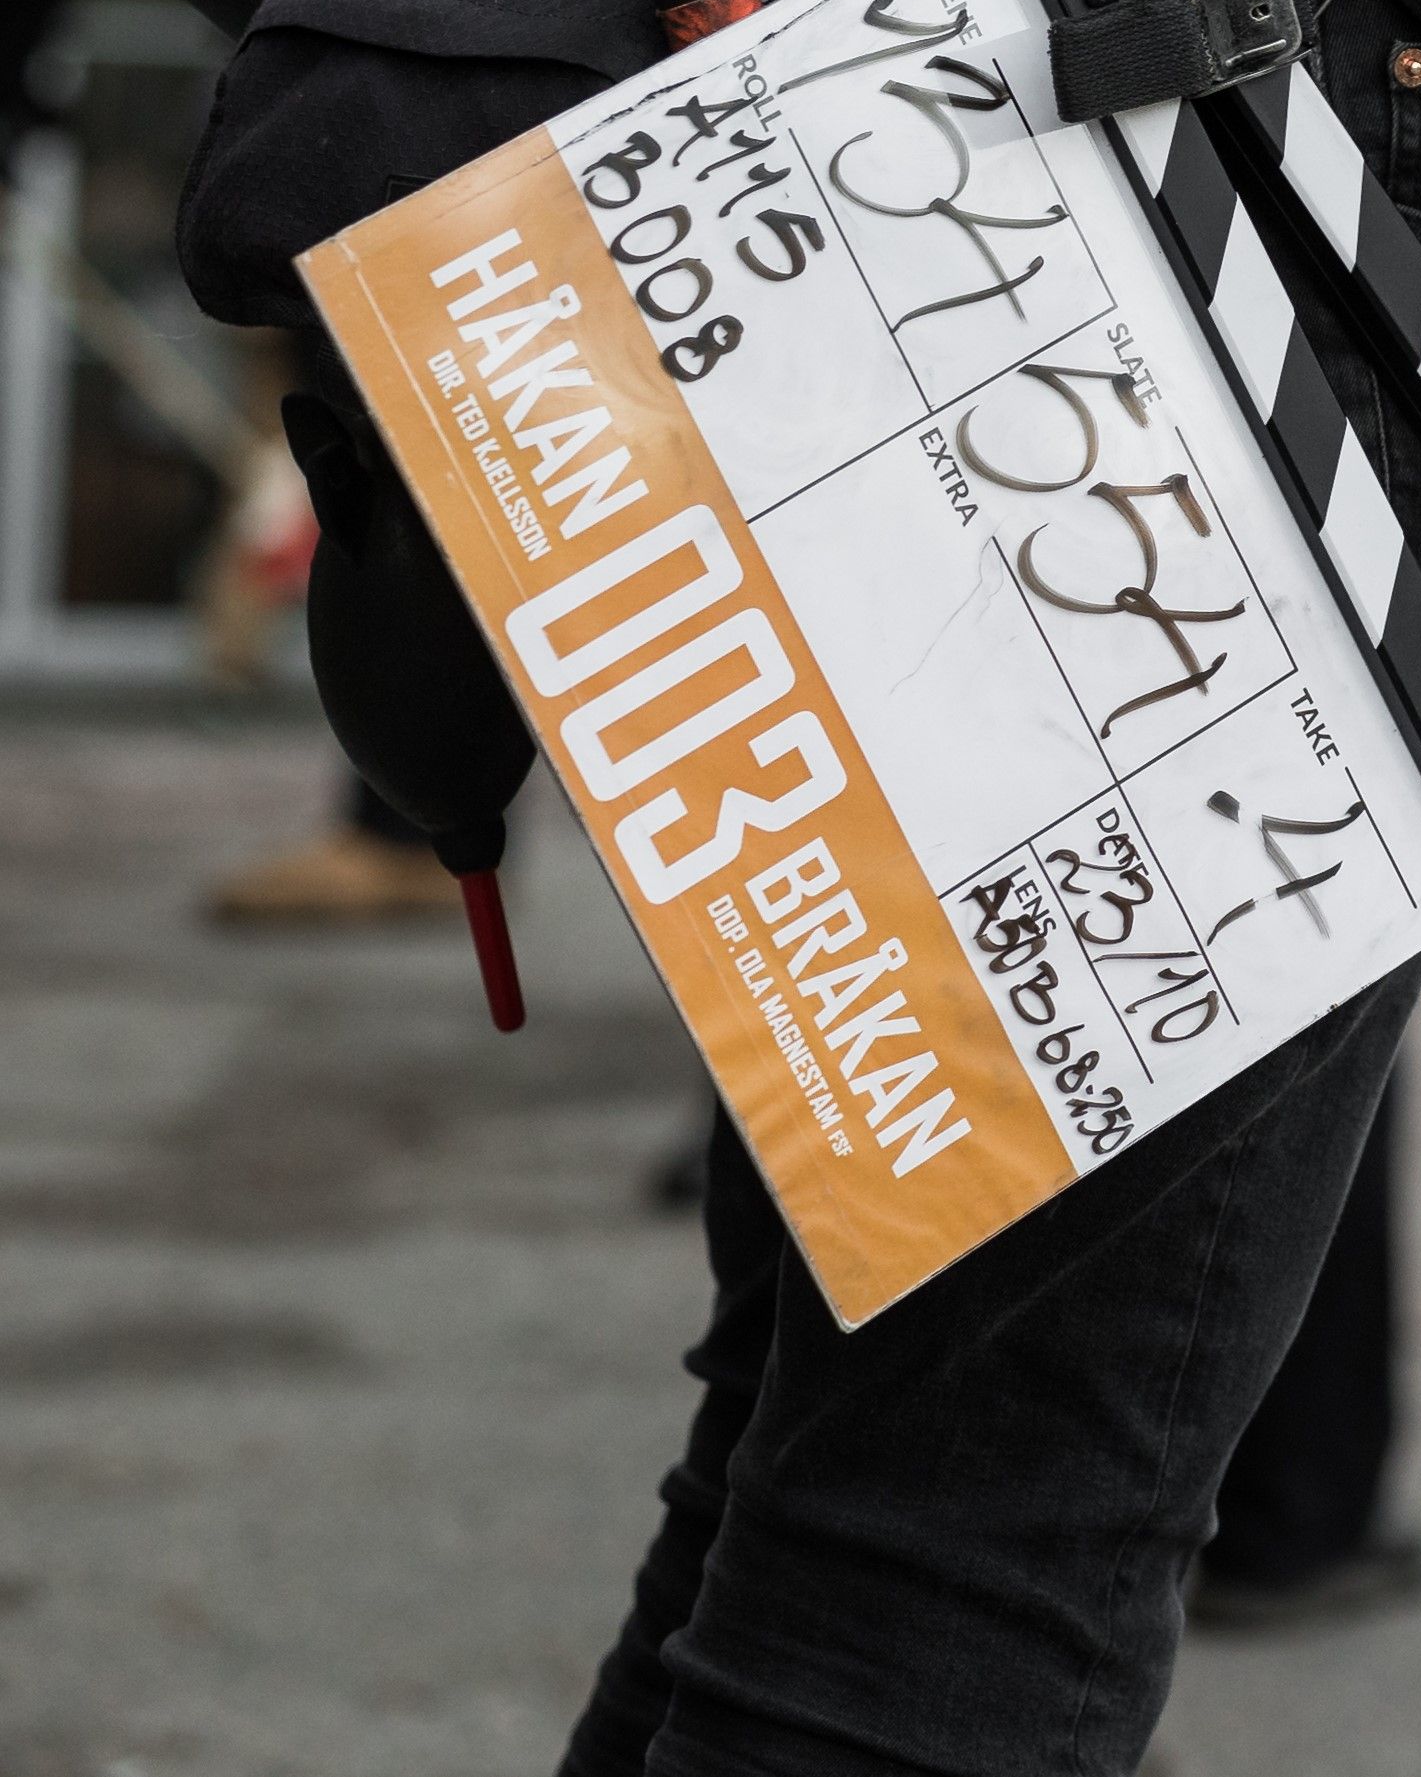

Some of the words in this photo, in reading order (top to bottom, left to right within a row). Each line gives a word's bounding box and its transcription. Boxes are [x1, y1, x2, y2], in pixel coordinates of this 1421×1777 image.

[665, 92, 825, 282] A115
[733, 54, 781, 132] ROLL
[582, 131, 743, 382] B008
[427, 345, 469, 399] DIR.
[452, 392, 490, 441] TED
[473, 438, 551, 560] KJELLSSON
[429, 221, 649, 540] HÅKAN
[1107, 323, 1161, 410] SLATE
[919, 427, 978, 526] EXTRA
[956, 364, 1245, 742] 554
[505, 503, 847, 905] 003
[1291, 688, 1339, 766] TAKE
[1005, 865, 1056, 942] LENS
[1096, 808, 1149, 886] DATE
[707, 894, 749, 953] DOP.
[735, 948, 774, 998] OLA
[759, 994, 843, 1130] MAGNESTAM
[826, 1127, 854, 1160] FSF
[745, 837, 972, 1178] BRÅKAN
